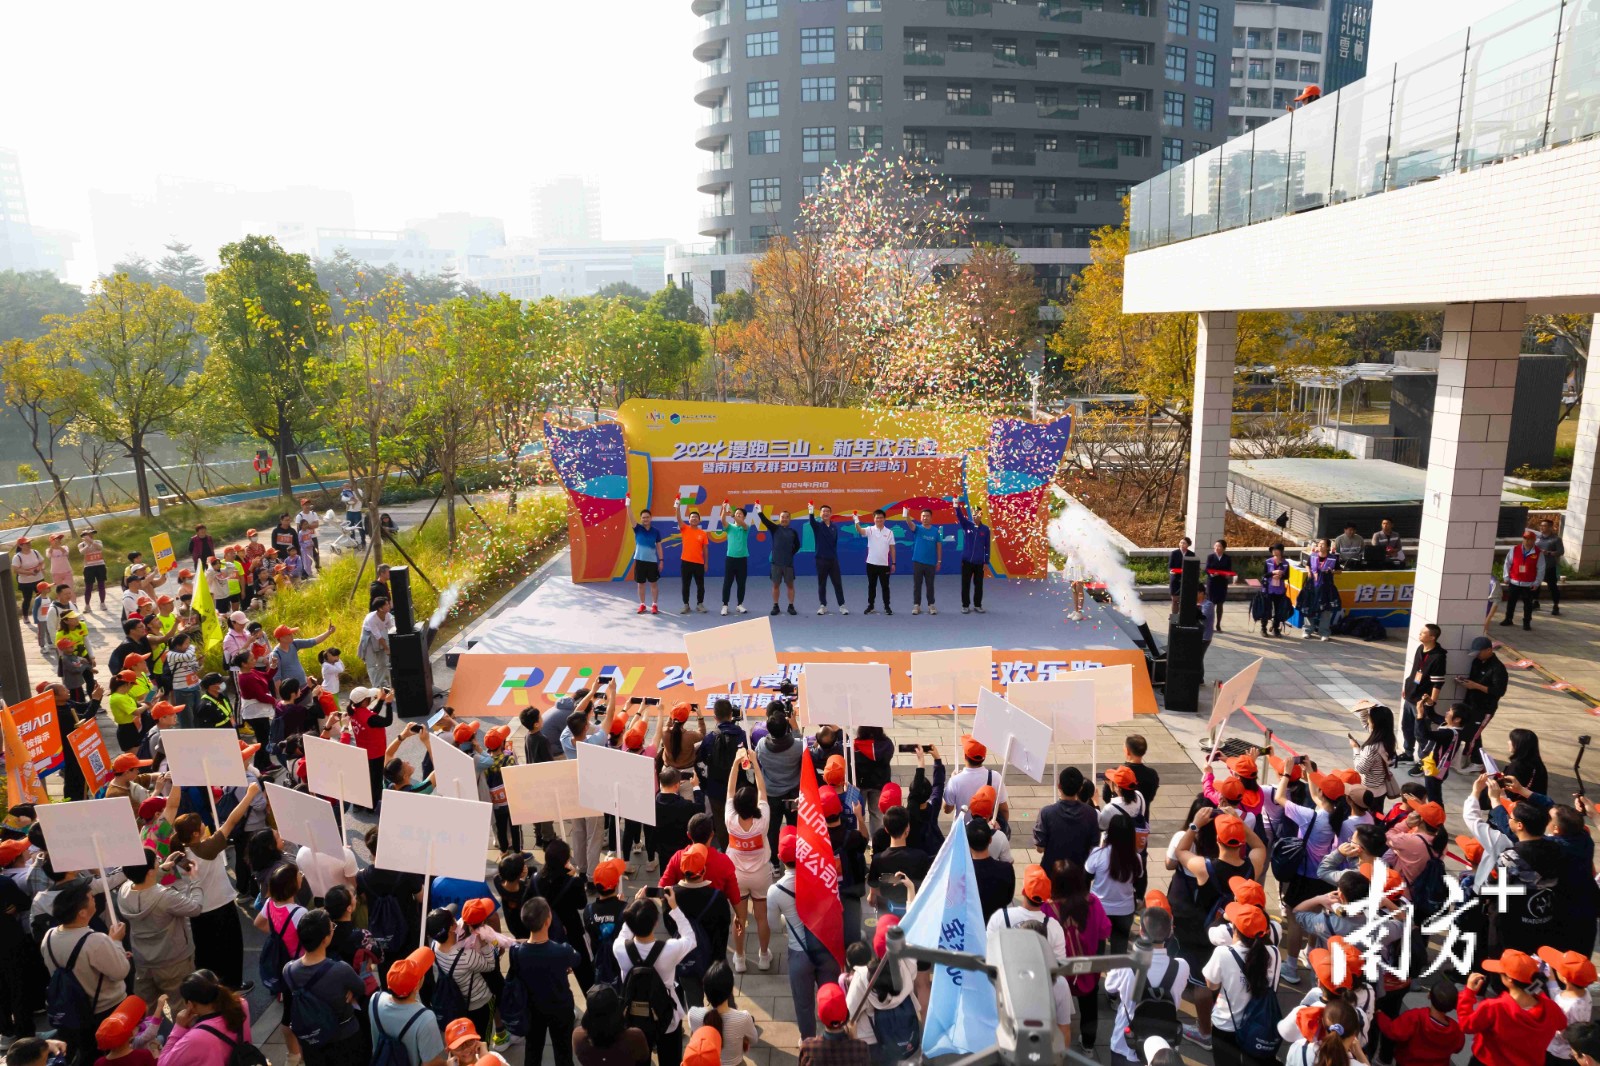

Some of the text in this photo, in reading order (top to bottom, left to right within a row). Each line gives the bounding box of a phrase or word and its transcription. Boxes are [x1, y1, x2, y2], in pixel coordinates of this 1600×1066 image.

[1354, 584, 1414, 603] 控台区
[23, 731, 51, 750] 按指示
[735, 839, 757, 849] 301
